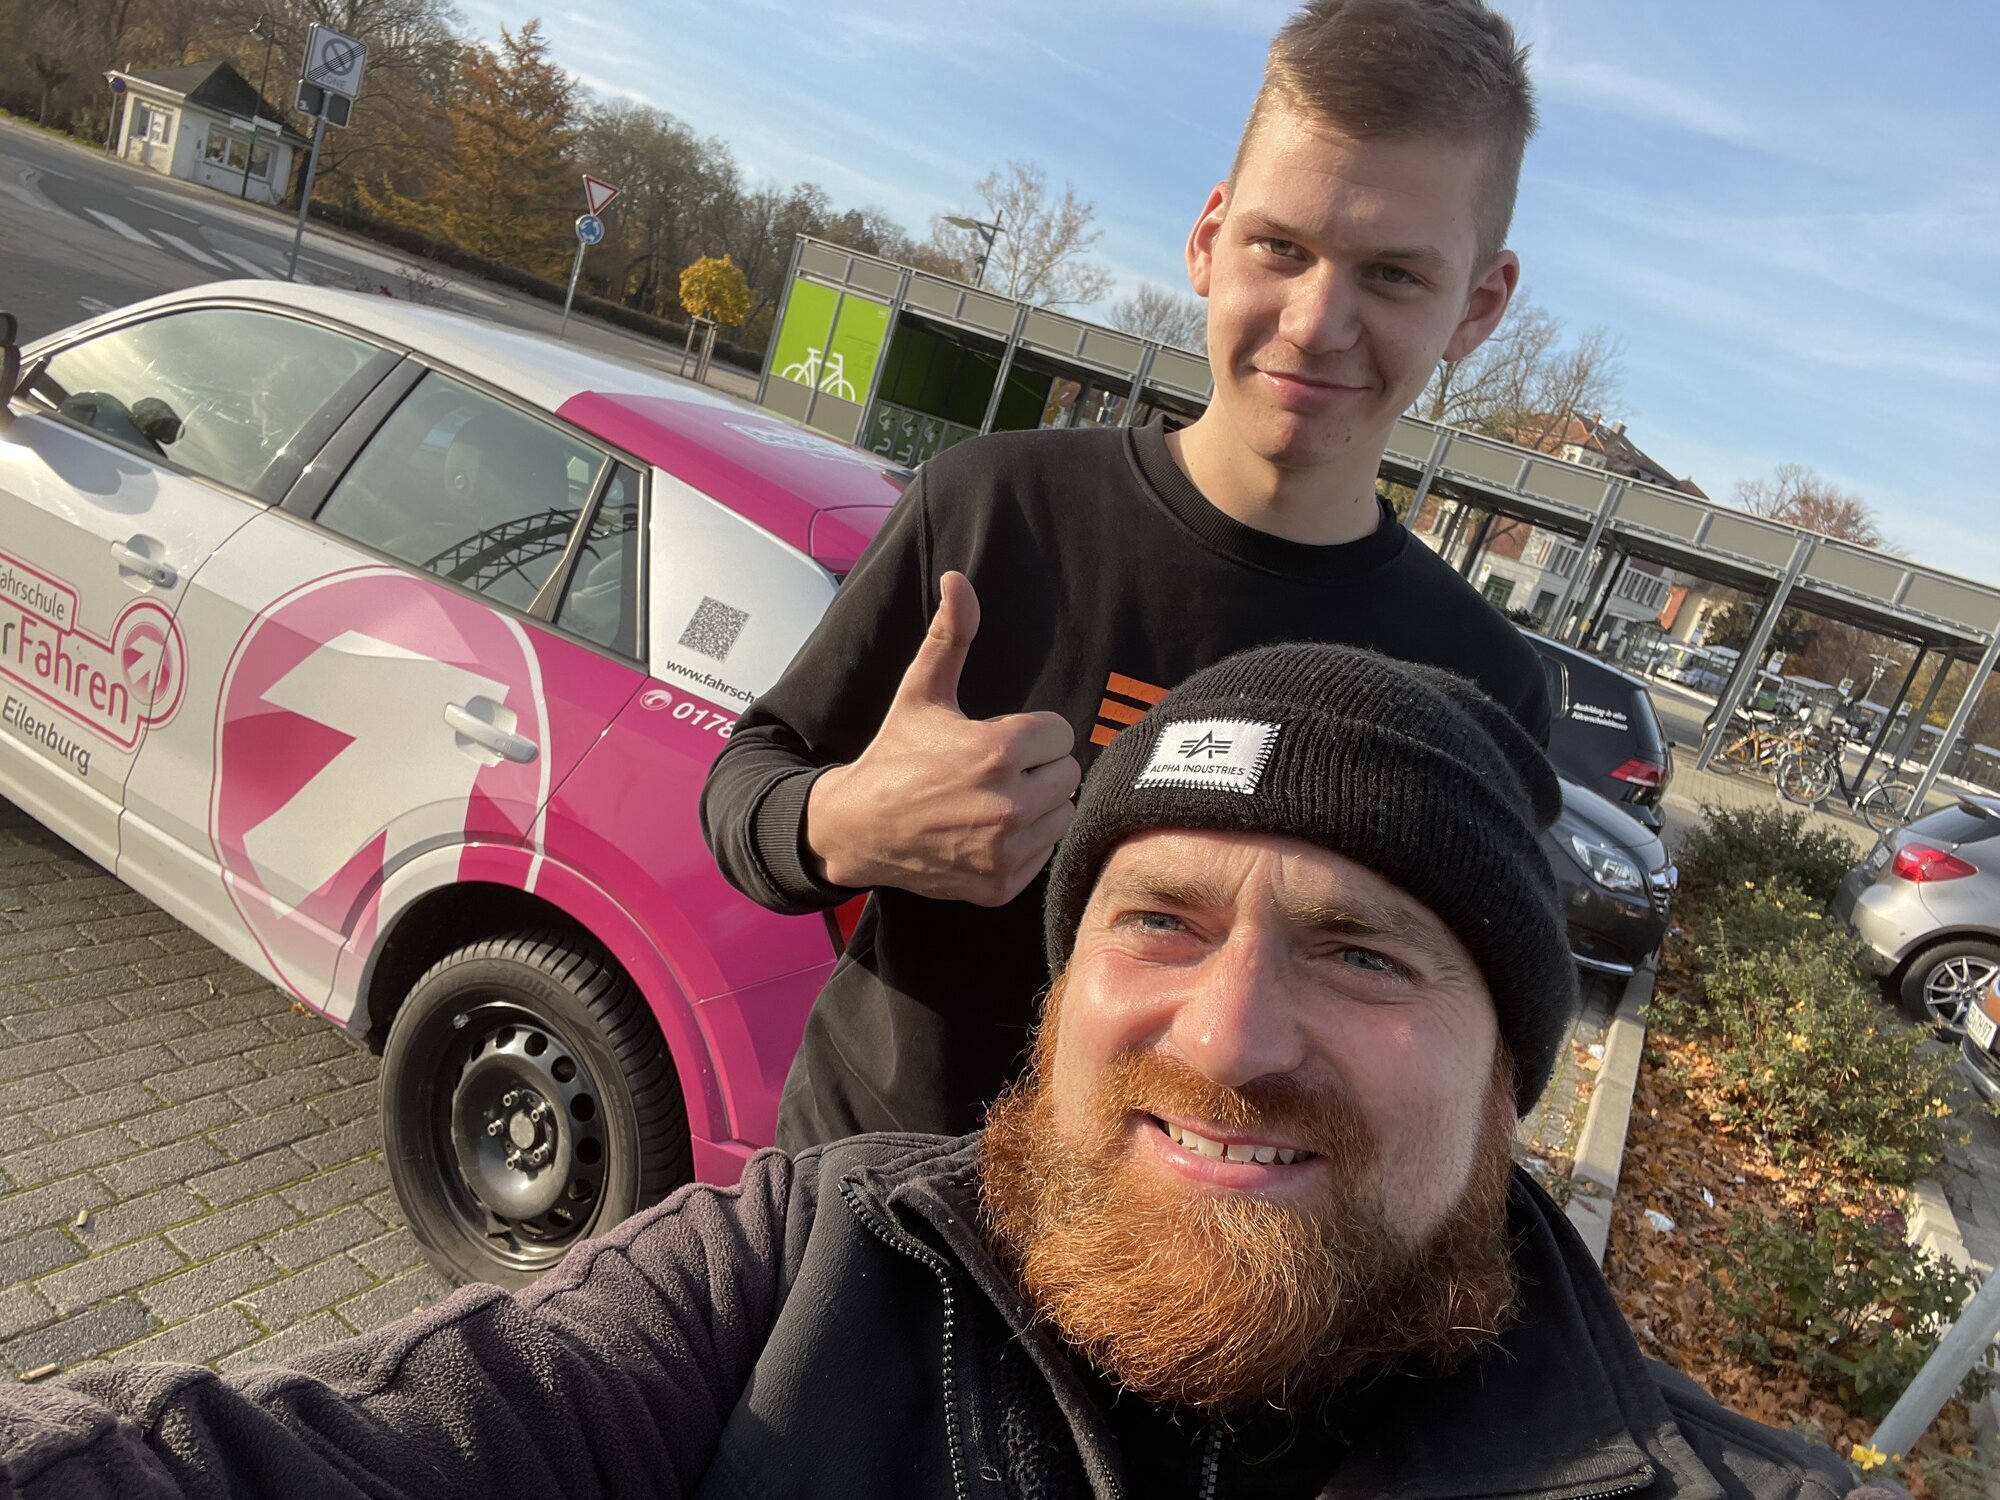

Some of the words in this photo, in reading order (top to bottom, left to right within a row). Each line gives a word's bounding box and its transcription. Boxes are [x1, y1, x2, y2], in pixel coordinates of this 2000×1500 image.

[0, 564, 65, 621] ahrschule
[2, 695, 91, 776] Eilenburg
[672, 702, 736, 738] 0178
[1150, 764, 1181, 774] ALPHA
[1182, 764, 1246, 776] INDUSTRIES
